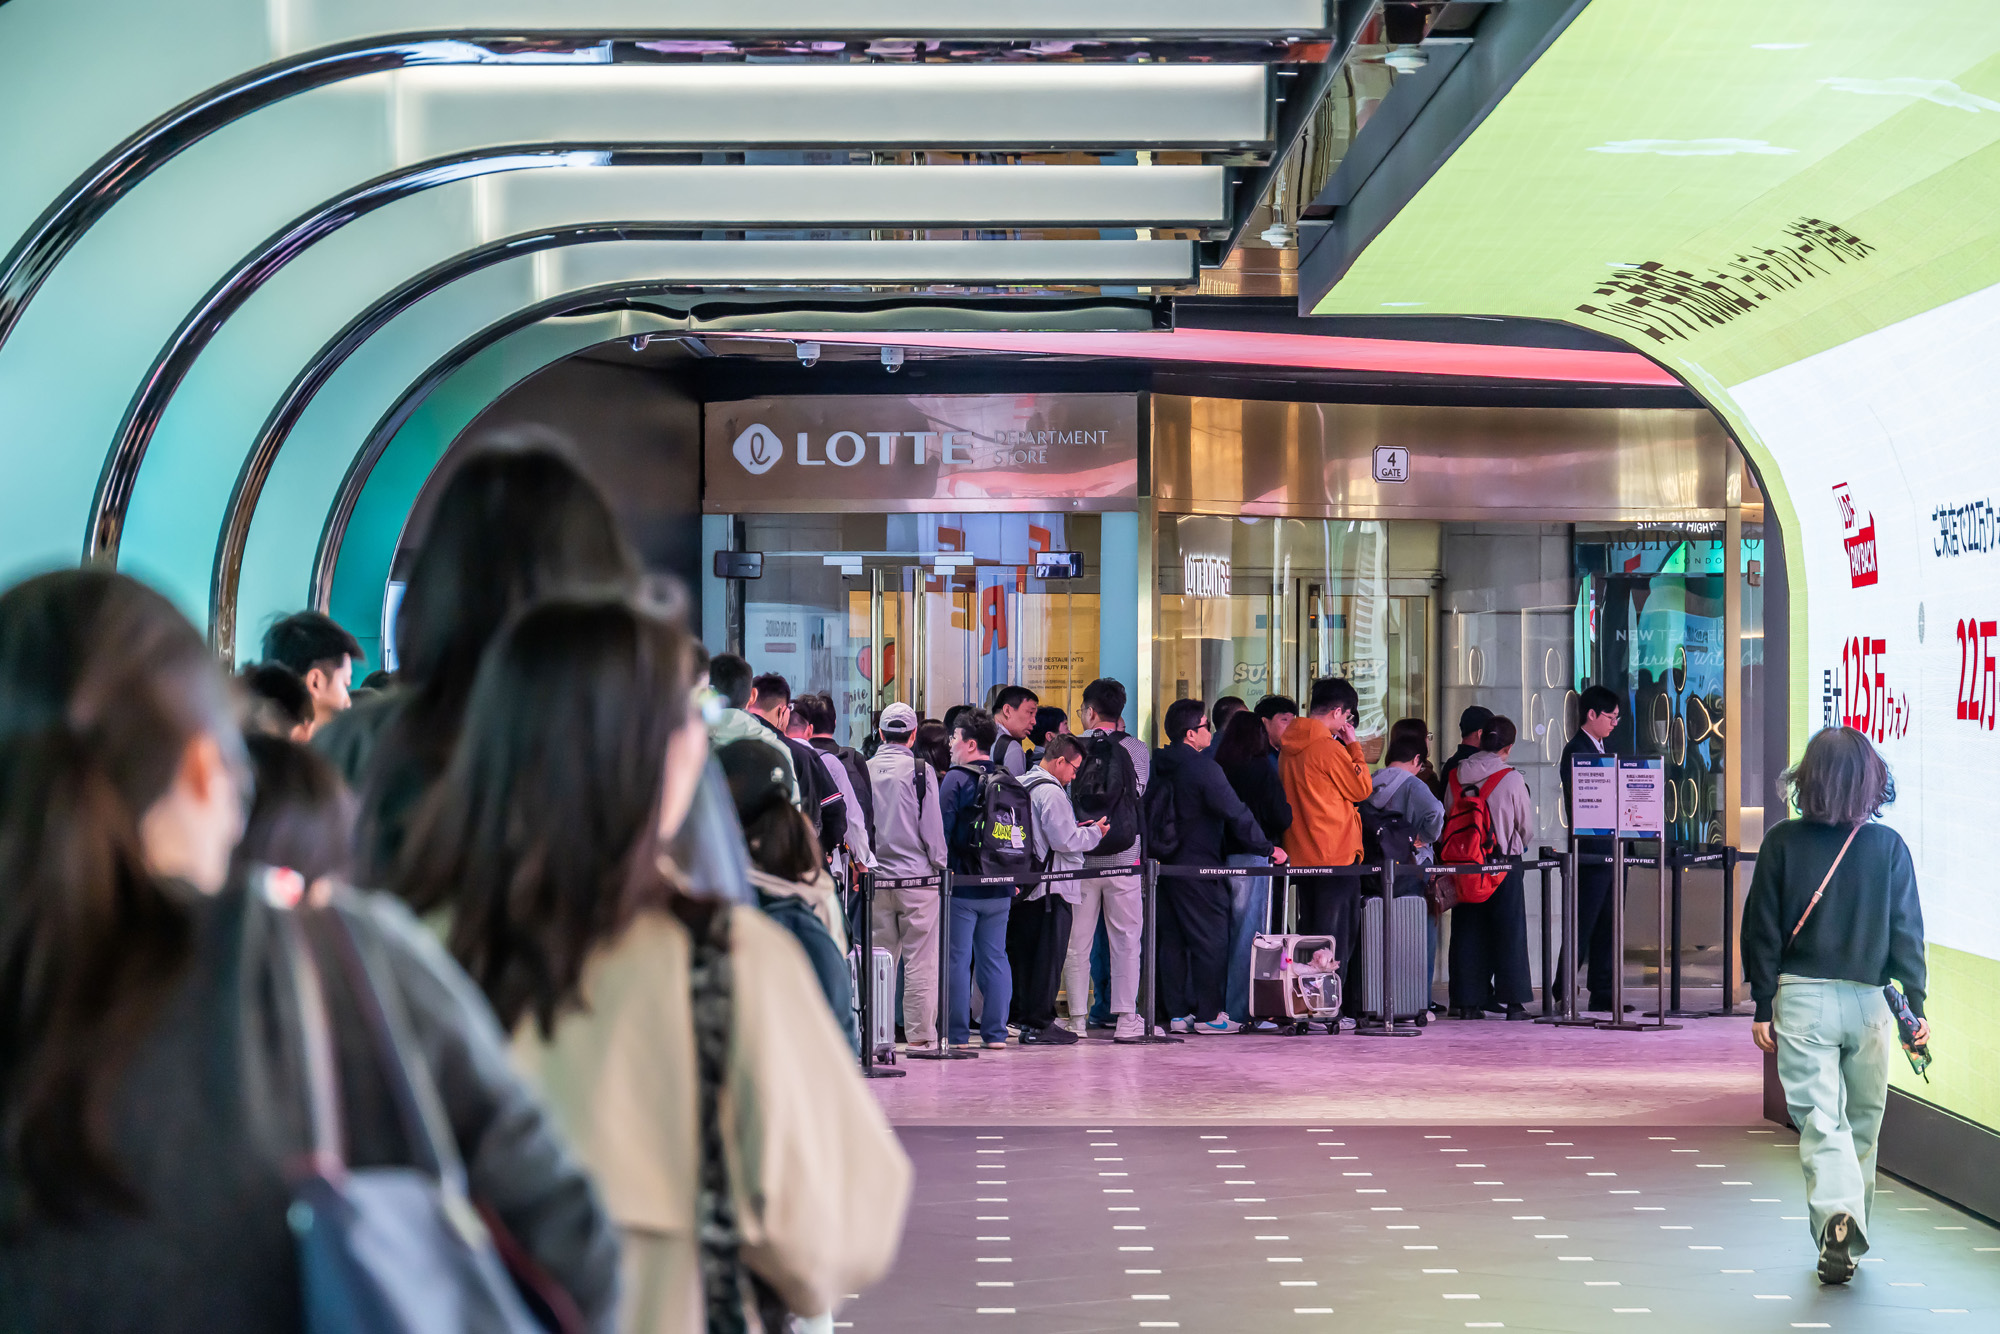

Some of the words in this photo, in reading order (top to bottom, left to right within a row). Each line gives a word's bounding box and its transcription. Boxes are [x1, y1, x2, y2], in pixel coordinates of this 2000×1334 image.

[796, 430, 974, 467] LOTTE
[994, 430, 1109, 445] DEPARTMENT
[994, 450, 1048, 465] STORE
[1387, 451, 1397, 467] 4
[1381, 468, 1401, 477] GATE
[1837, 493, 1855, 530] LDF
[1932, 496, 2000, 559] ご来店で22万ウ
[1674, 557, 1722, 565] LONDO
[1850, 539, 1877, 577] PAYBACK
[1957, 617, 2000, 732] 22万
